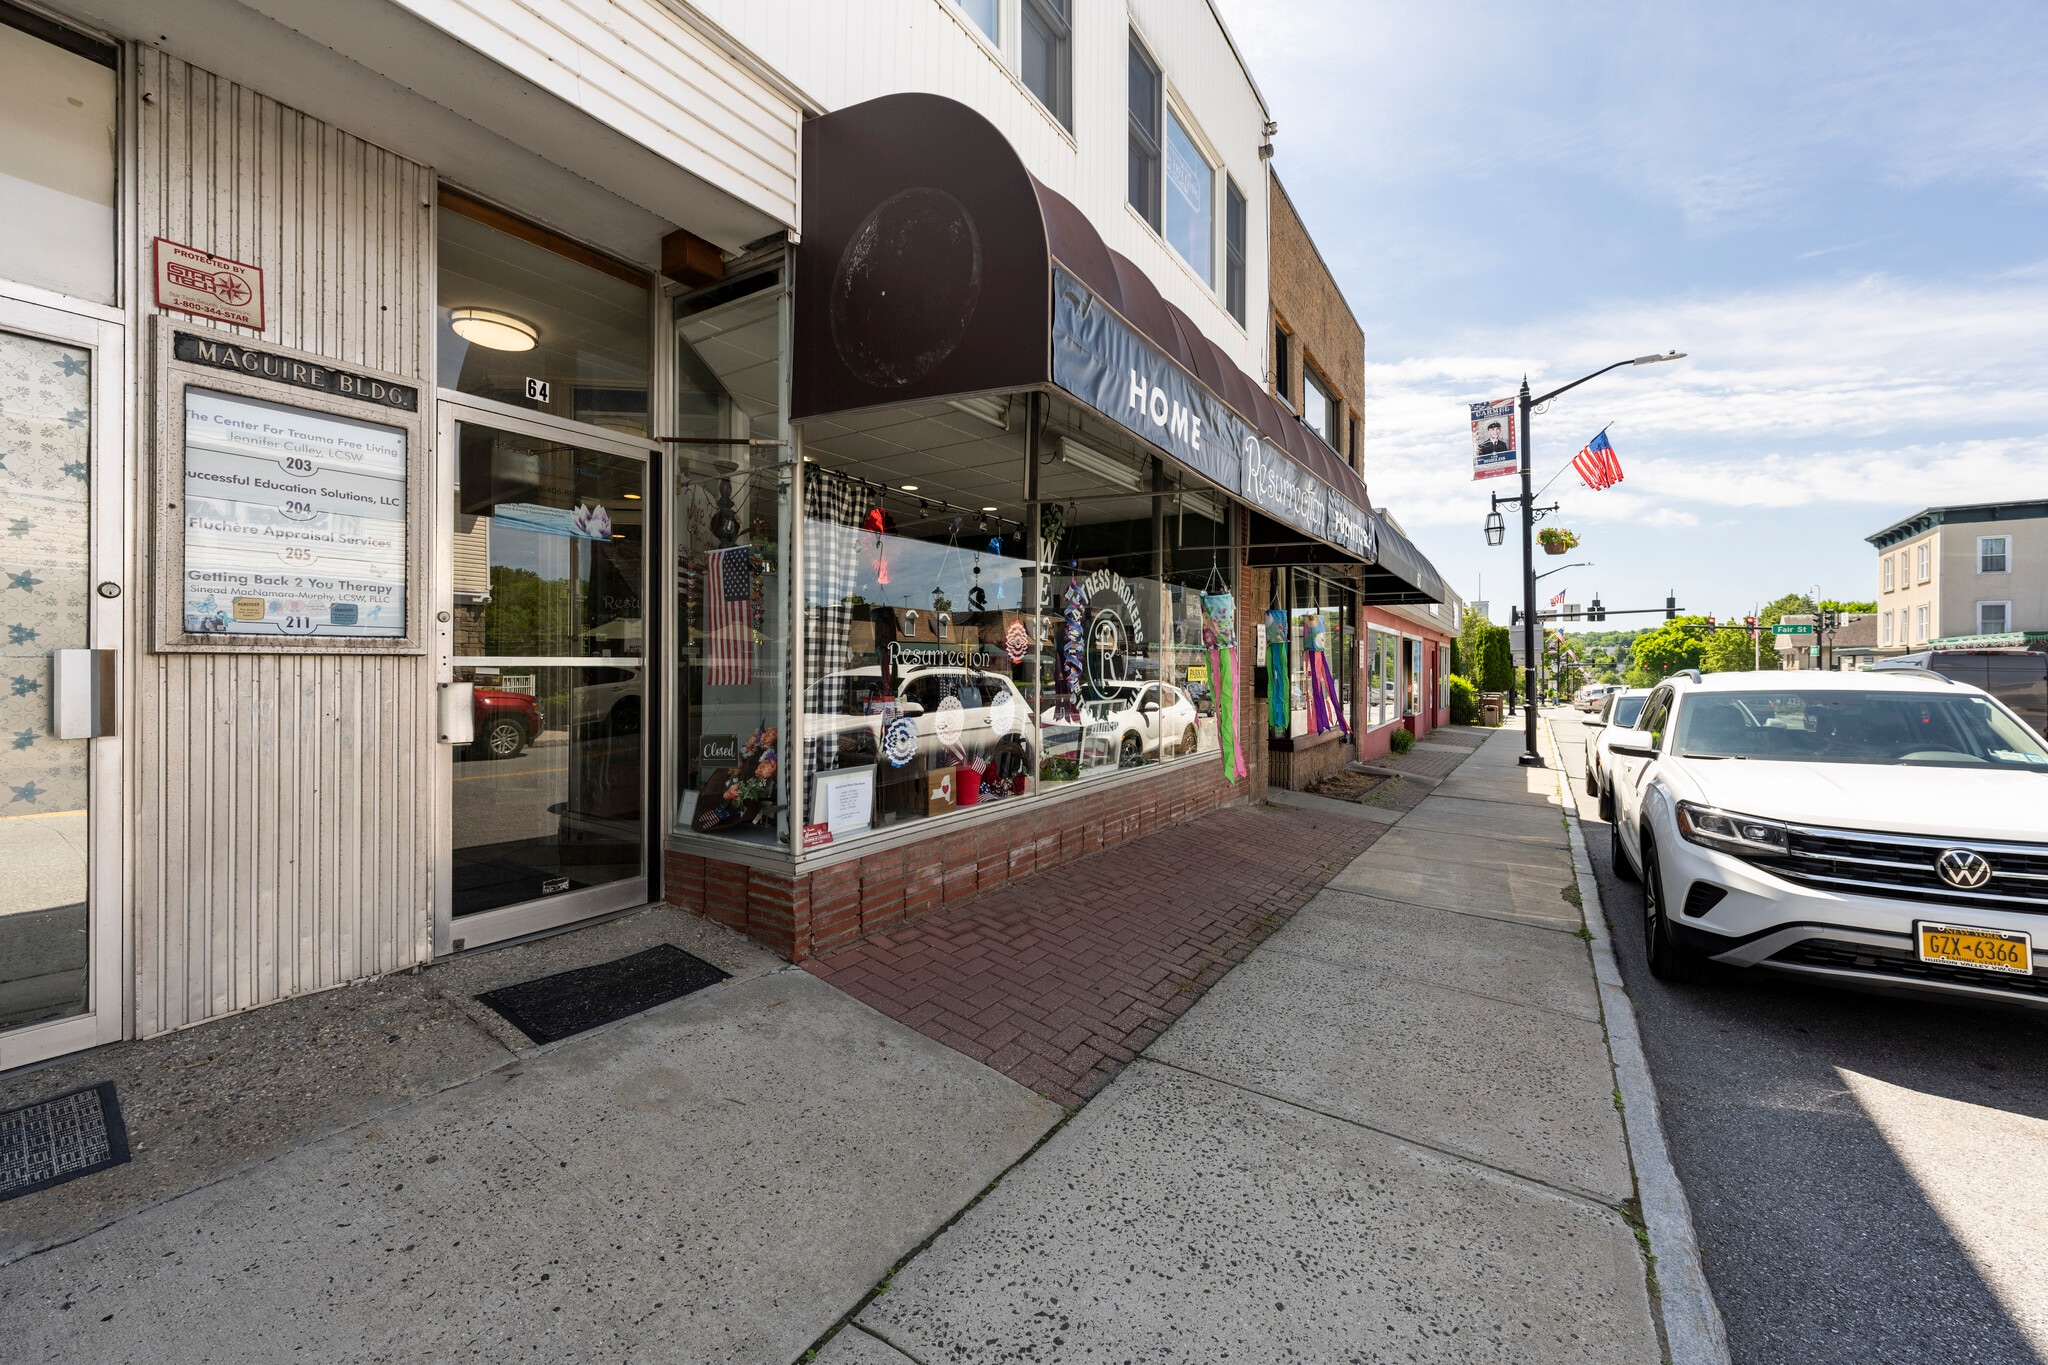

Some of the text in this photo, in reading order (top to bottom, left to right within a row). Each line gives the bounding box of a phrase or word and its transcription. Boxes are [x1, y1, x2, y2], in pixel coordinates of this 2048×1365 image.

[174, 248, 246, 274] PROTECTED BY
[173, 298, 249, 323] 1-800-344-STAR
[182, 293, 196, 301] Tech
[196, 297, 219, 309] Security
[197, 340, 408, 406] MAGUIRE BLDG.
[528, 379, 548, 401] 64
[1129, 367, 1201, 451] HOME
[185, 409, 398, 458] The Center For Trauma Free Living
[228, 431, 363, 462] Jennifer Culley, LCSW
[286, 456, 312, 471] 203
[184, 470, 400, 507] uccessful Education Solutions, LLC
[1245, 436, 1325, 527] Resurrection
[286, 500, 311, 515] 204
[189, 517, 392, 549] Fluchère Appraisal Services
[285, 547, 311, 560] 205
[188, 570, 393, 595] Getting Back 2 You Therapy
[190, 584, 227, 594] Sinead
[338, 593, 367, 603] LCSW,
[369, 595, 391, 604] PLLC
[1112, 571, 1144, 645] BROKERS
[286, 616, 310, 629] 211
[887, 640, 990, 667] Resurrection
[703, 741, 736, 758] Closed
[1945, 927, 1971, 936] NEW
[1975, 930, 2001, 940] YORK
[1925, 957, 1958, 965] HUDSON
[1960, 961, 1989, 969] VALLEY
